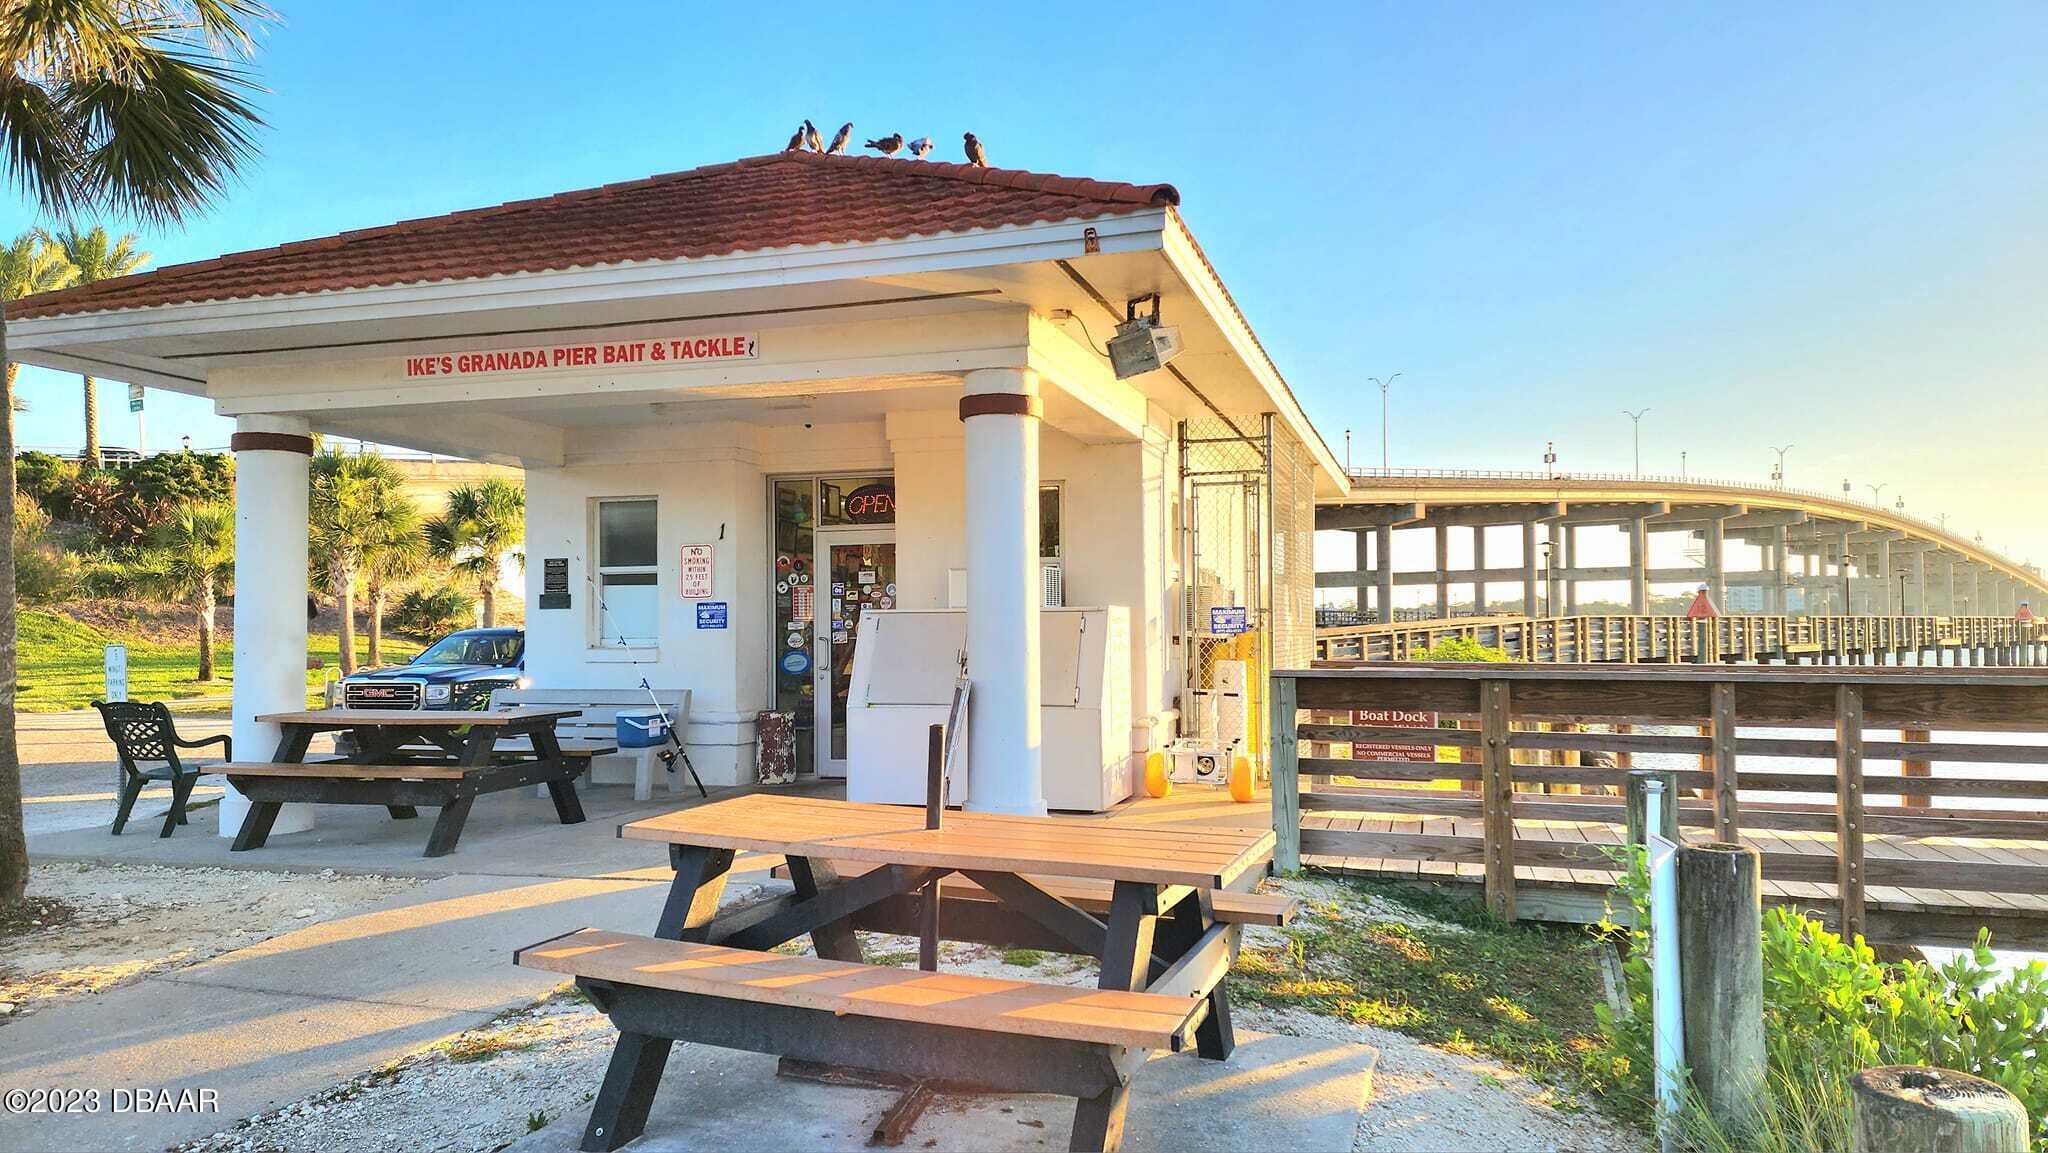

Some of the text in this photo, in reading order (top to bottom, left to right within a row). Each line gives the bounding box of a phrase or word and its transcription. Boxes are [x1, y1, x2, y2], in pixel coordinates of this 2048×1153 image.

[407, 336, 745, 377] IKE'S GRANADA PIER BAIT & TACKLE
[849, 494, 896, 514] OPEN
[719, 522, 725, 540] 1
[690, 548, 703, 556] NO
[364, 688, 394, 698] GMC
[1360, 710, 1428, 722] Boat Dock
